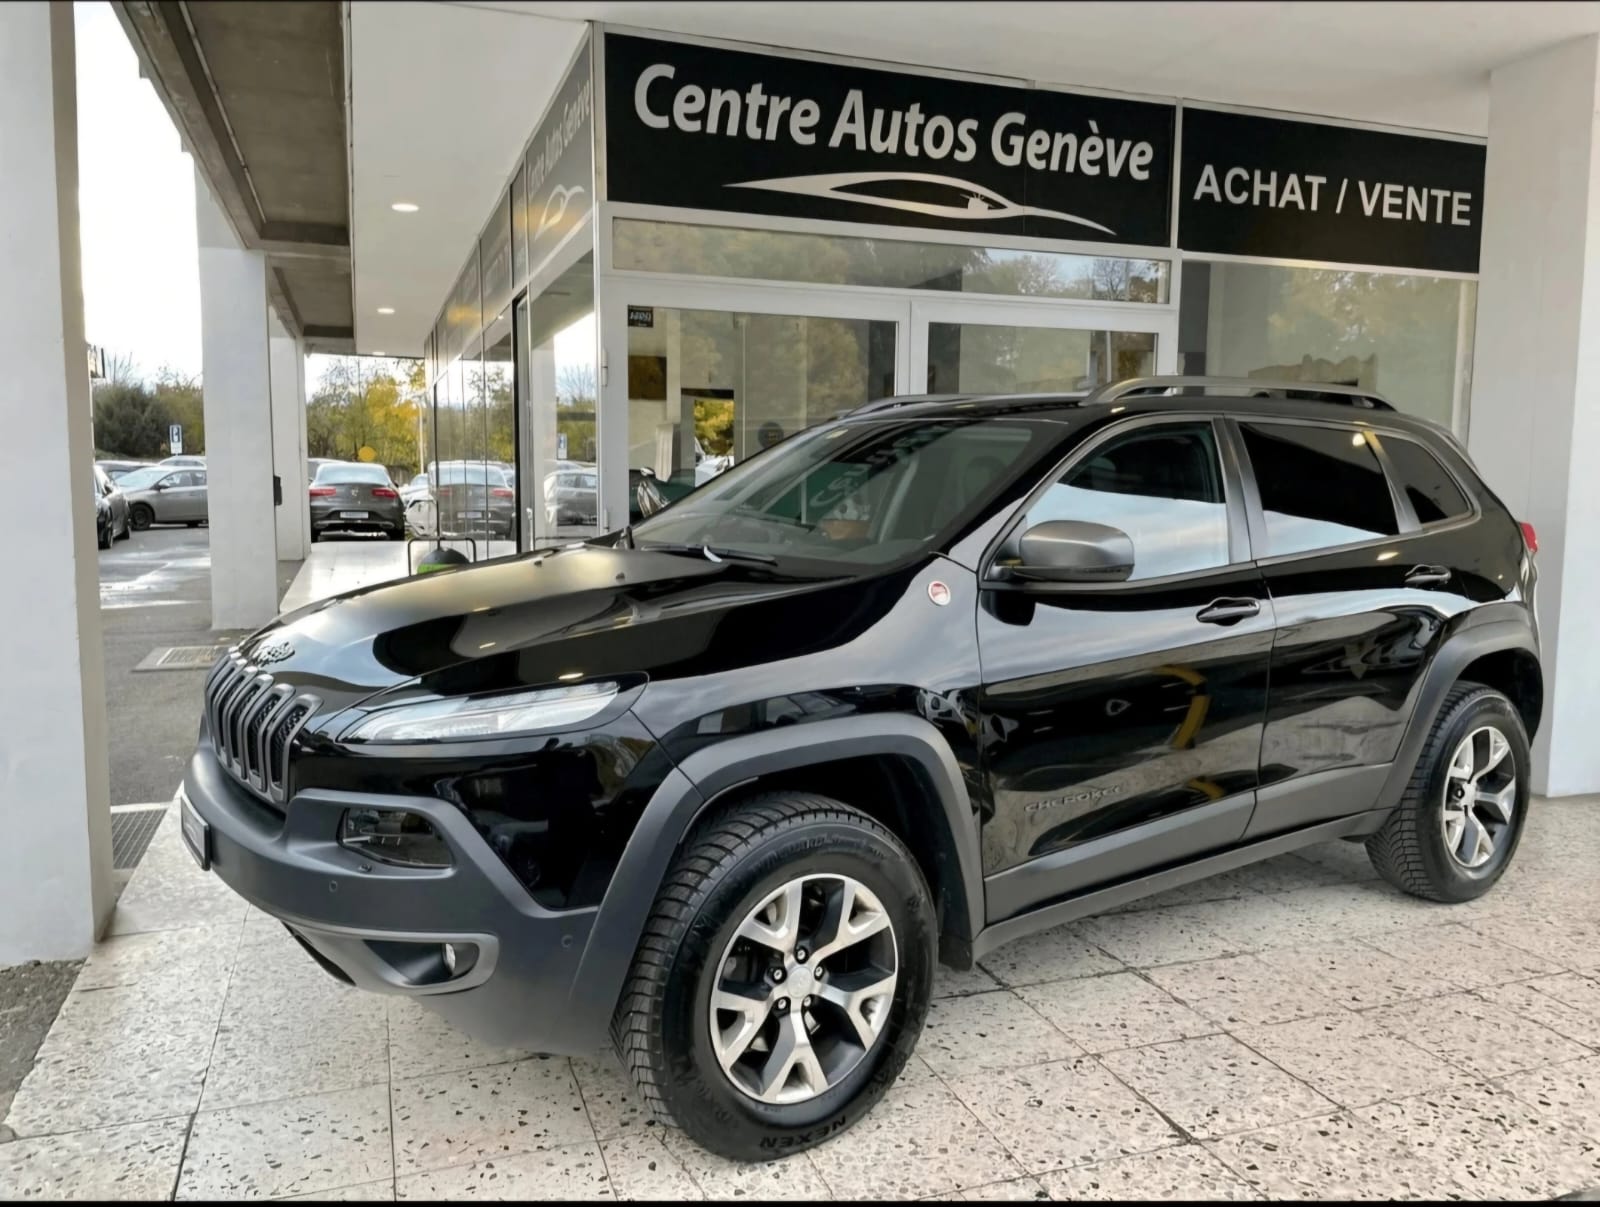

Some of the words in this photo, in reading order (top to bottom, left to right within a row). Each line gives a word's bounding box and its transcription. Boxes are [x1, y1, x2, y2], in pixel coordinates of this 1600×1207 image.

[634, 63, 821, 146] Centre
[828, 88, 979, 163] Autos
[991, 111, 1154, 181] Genève
[1193, 163, 1327, 212] ACHAT
[1335, 178, 1349, 214] /
[1358, 179, 1473, 227] VENTE
[759, 1115, 847, 1149] NEXEN
